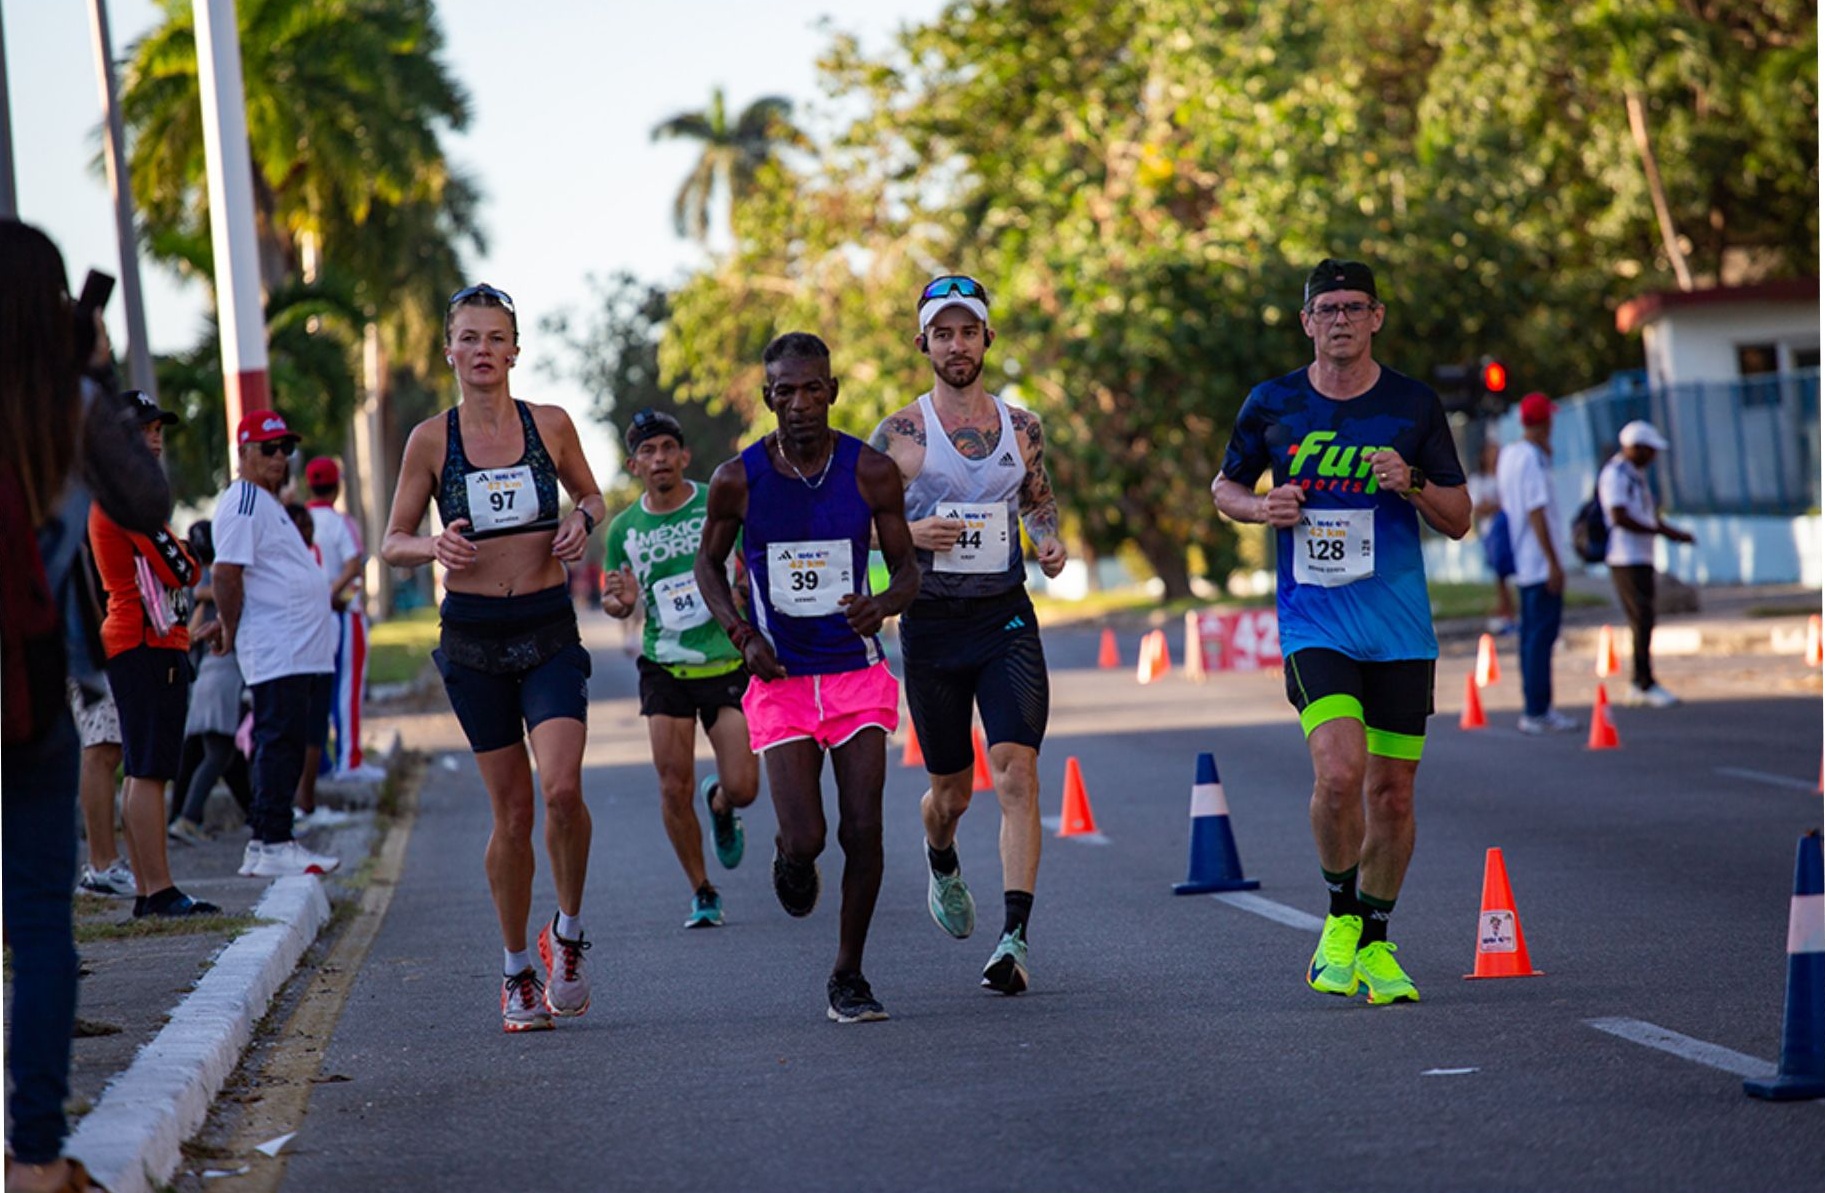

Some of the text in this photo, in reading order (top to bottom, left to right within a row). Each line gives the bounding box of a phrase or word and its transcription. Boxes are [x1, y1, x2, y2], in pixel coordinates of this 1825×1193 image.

[490, 490, 515, 512] 97
[955, 531, 982, 549] 44
[1308, 527, 1346, 538] 42 km
[1306, 539, 1344, 561] 128
[789, 559, 826, 569] 42 km
[791, 570, 818, 591] 39
[673, 593, 694, 611] 84
